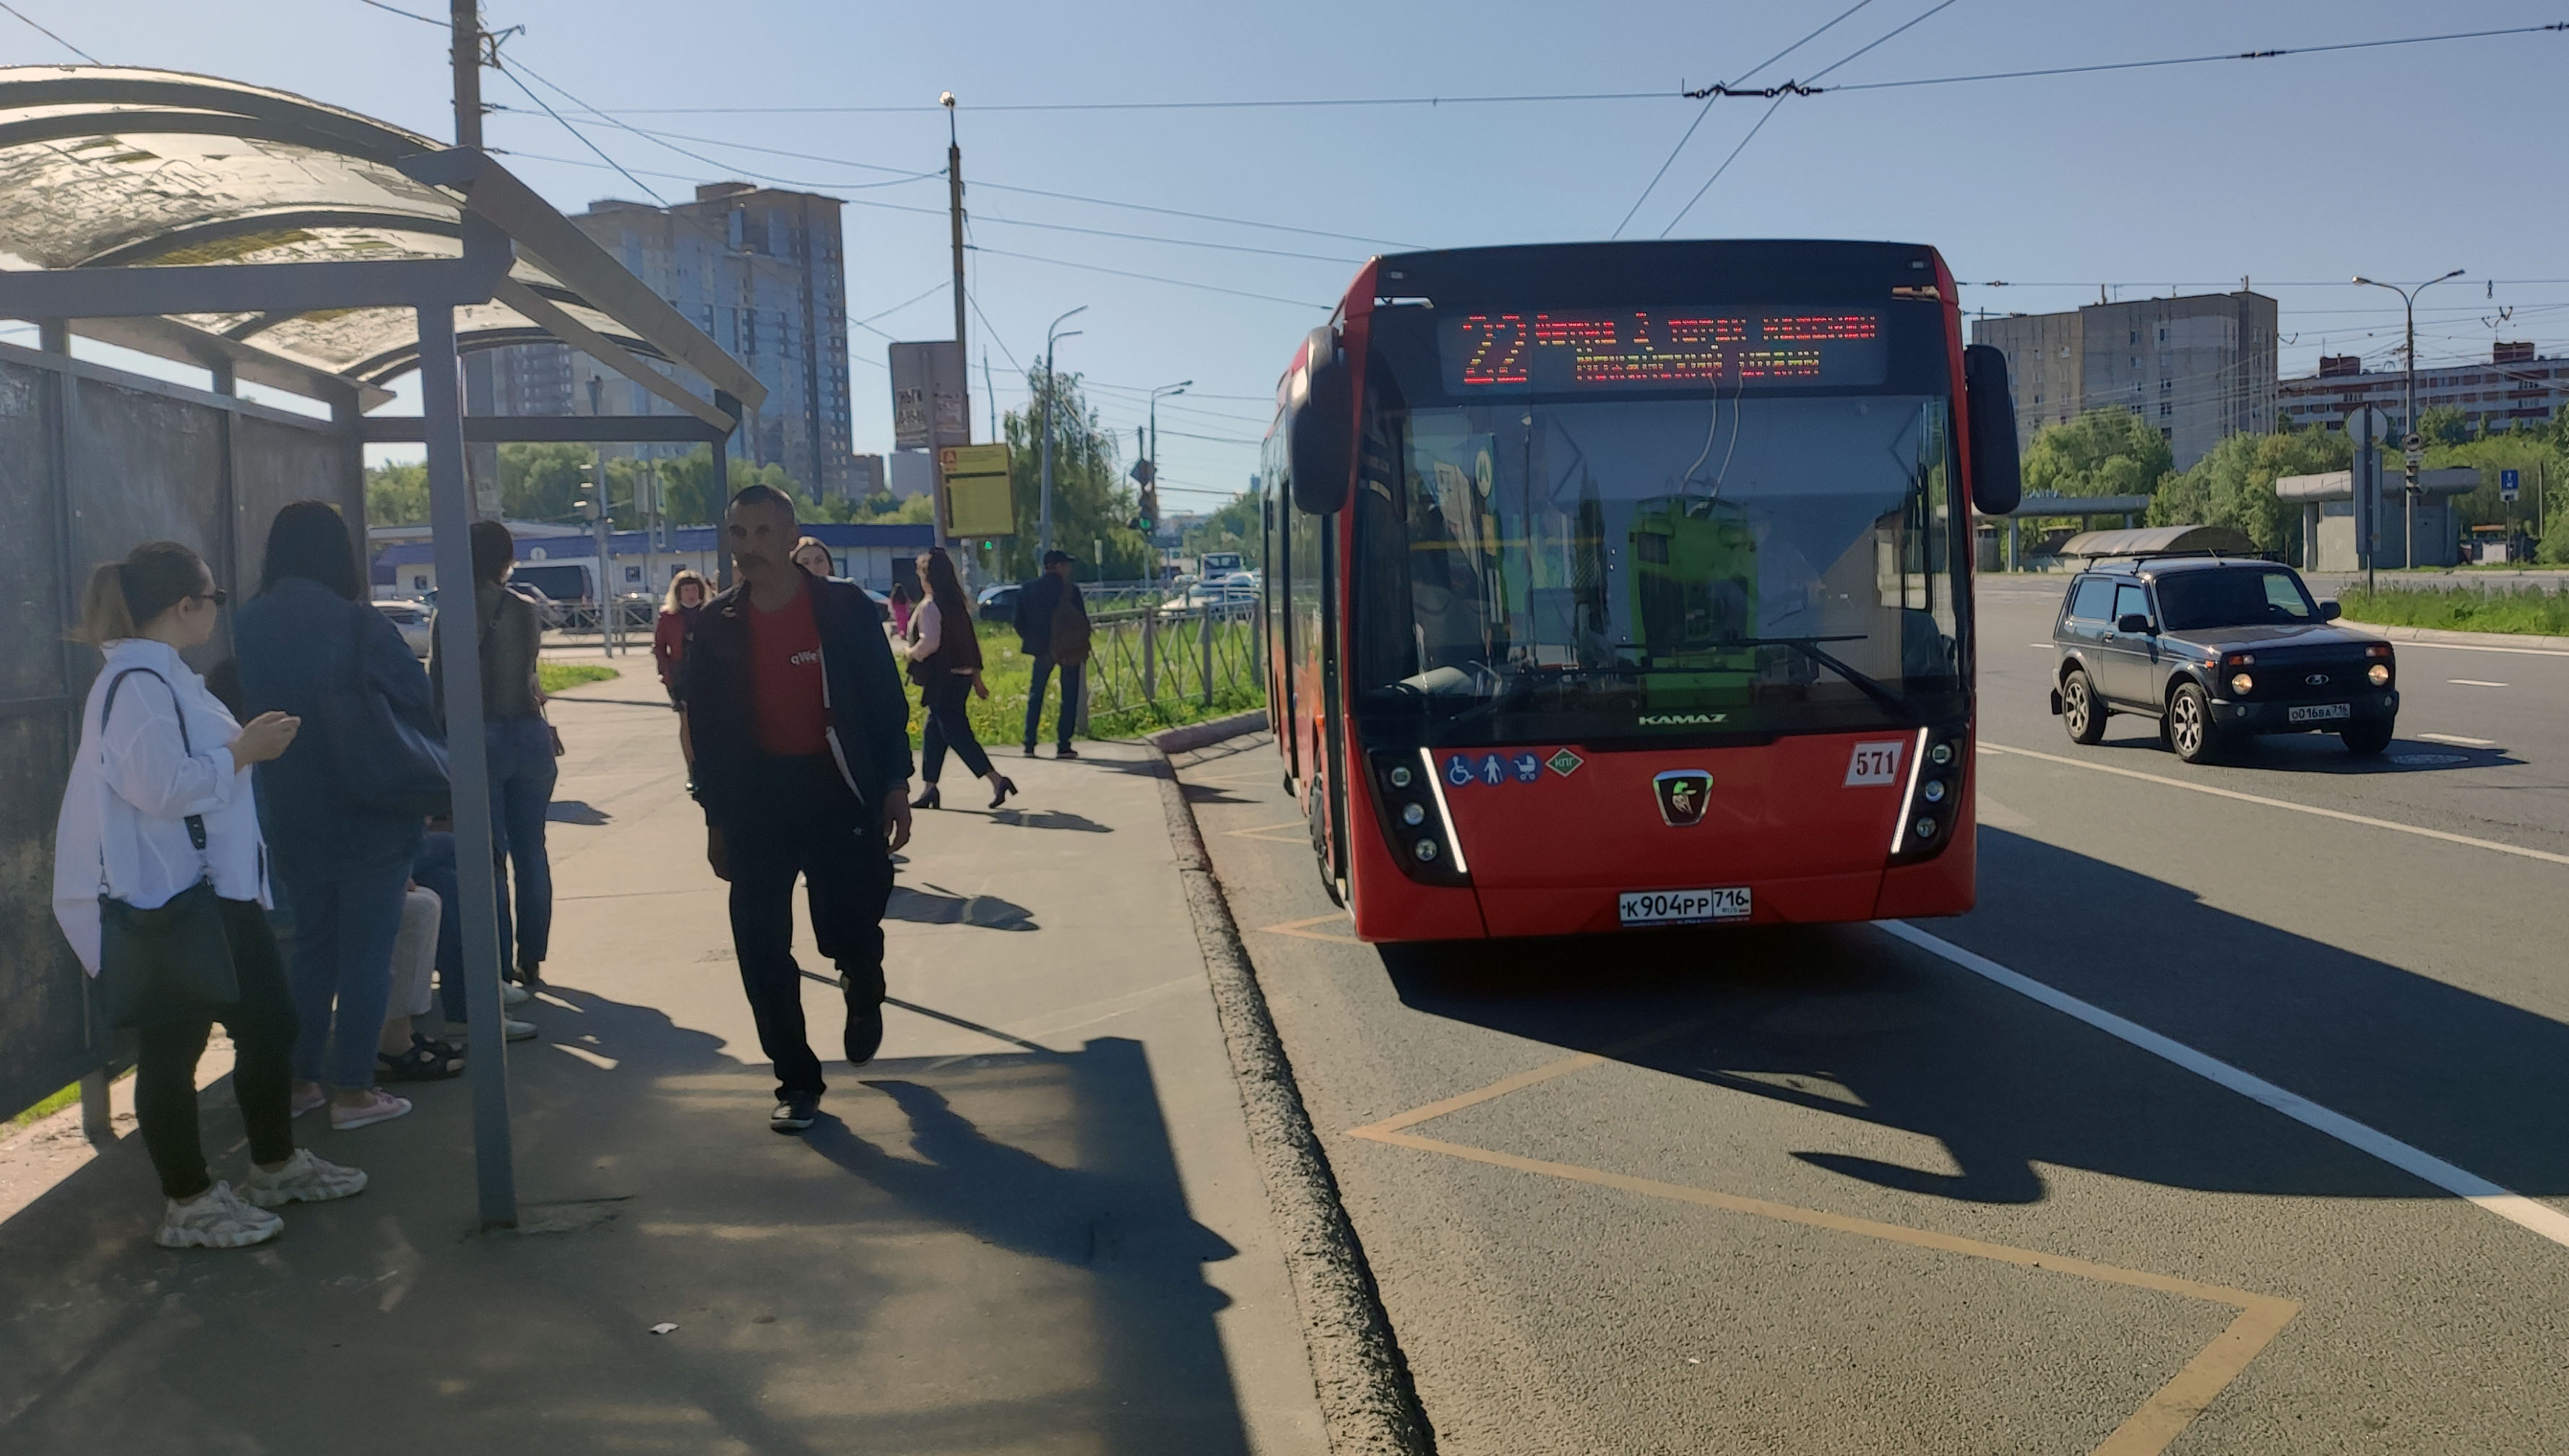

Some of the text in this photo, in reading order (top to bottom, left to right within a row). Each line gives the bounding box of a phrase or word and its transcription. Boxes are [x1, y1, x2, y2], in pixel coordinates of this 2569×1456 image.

[1461, 313, 1529, 384] 22
[1638, 714, 1726, 724] KAMAZ
[1555, 757, 1573, 767] КПГ
[1857, 750, 1894, 776] 571
[1627, 890, 1745, 917] К904РР 716
